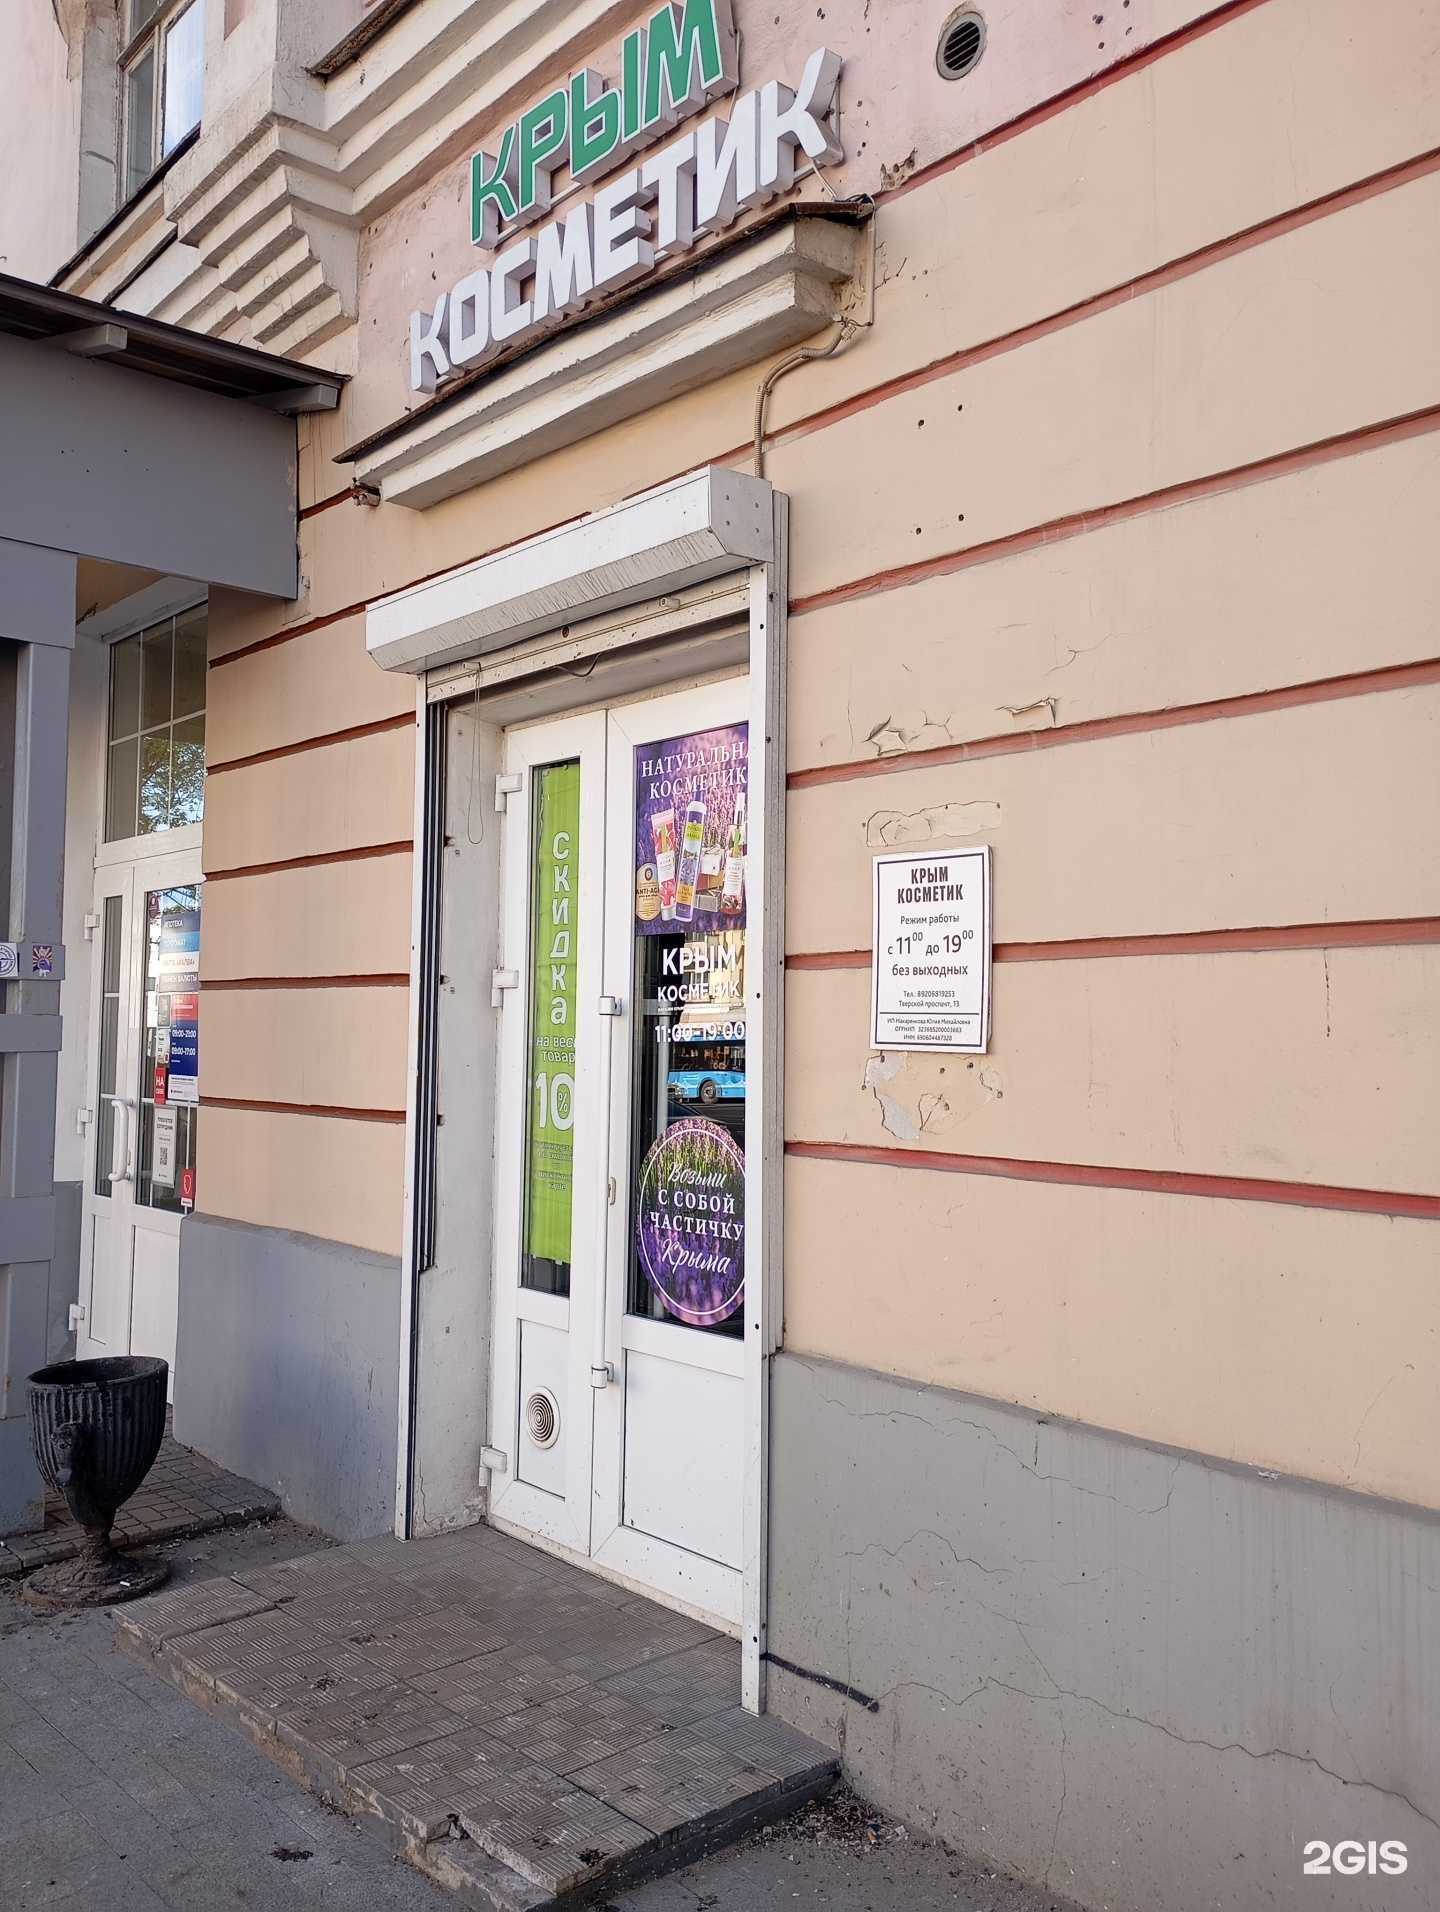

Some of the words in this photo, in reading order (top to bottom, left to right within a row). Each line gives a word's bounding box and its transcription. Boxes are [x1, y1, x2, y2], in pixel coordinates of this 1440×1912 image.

[470, 0, 730, 248] КРЫМ
[410, 47, 842, 393] КОСМЕТИК
[641, 741, 749, 778] НАТУРАЛЬН
[911, 866, 949, 884] КРЫМ
[897, 884, 964, 904] КОСМЕТИК
[900, 915, 927, 925] Режим
[928, 913, 960, 926] работы
[662, 944, 736, 976] КРЫМ
[887, 945, 893, 955] с
[925, 944, 940, 956] до
[892, 964, 910, 976] без
[912, 965, 968, 978] выходных
[898, 1000, 924, 1009] Тверской
[536, 1035, 549, 1048] на
[553, 1035, 576, 1048] вес
[668, 1161, 727, 1189] Возьми
[674, 1191, 736, 1215] СОБОЙ
[650, 1211, 745, 1241] ЧАСТИЧКУ
[662, 1238, 731, 1275] Крыма
